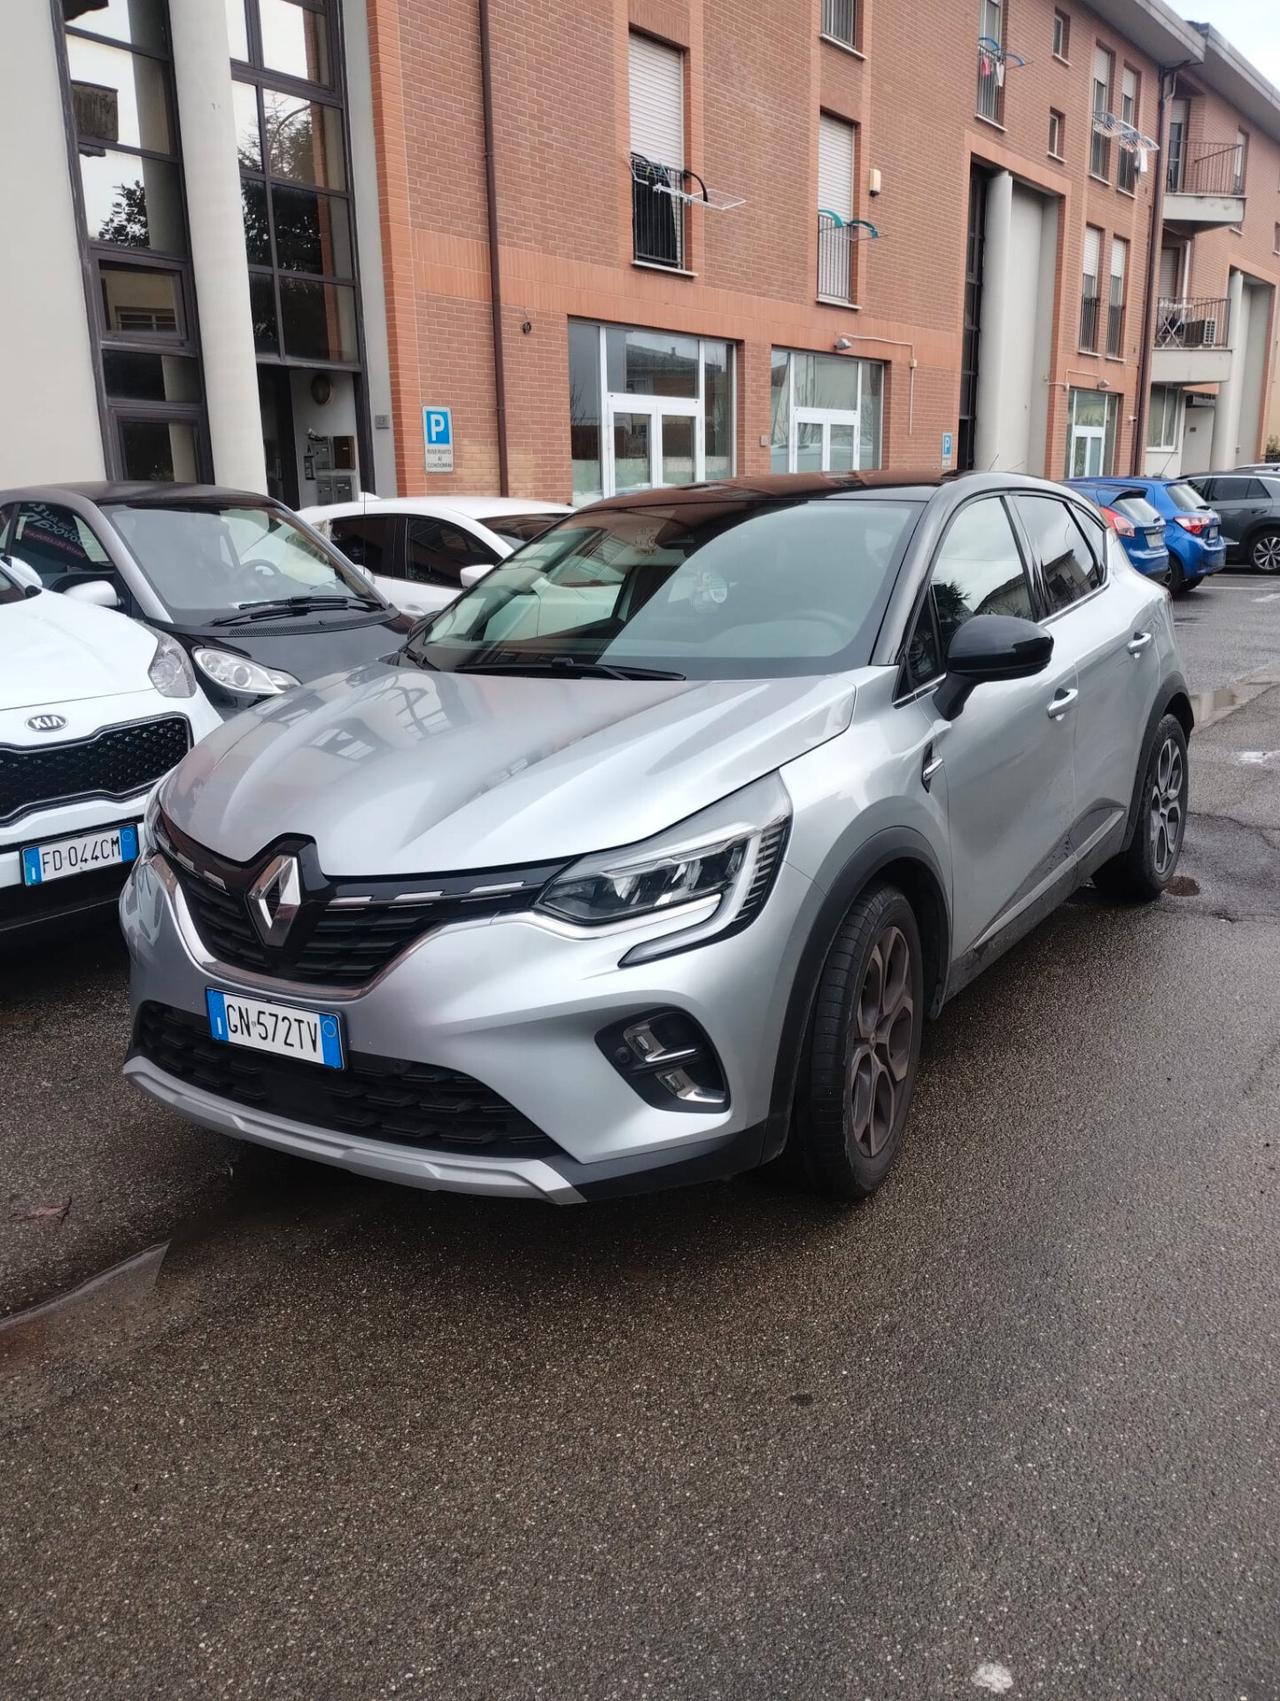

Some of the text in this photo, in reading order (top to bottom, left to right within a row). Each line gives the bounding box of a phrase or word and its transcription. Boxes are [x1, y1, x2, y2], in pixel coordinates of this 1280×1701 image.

[430, 414, 445, 441] P
[31, 716, 64, 729] KIA
[42, 849, 63, 874] FD
[68, 836, 121, 867] 044CM
[226, 1004, 251, 1038] GN
[257, 1010, 317, 1053] 572TV
